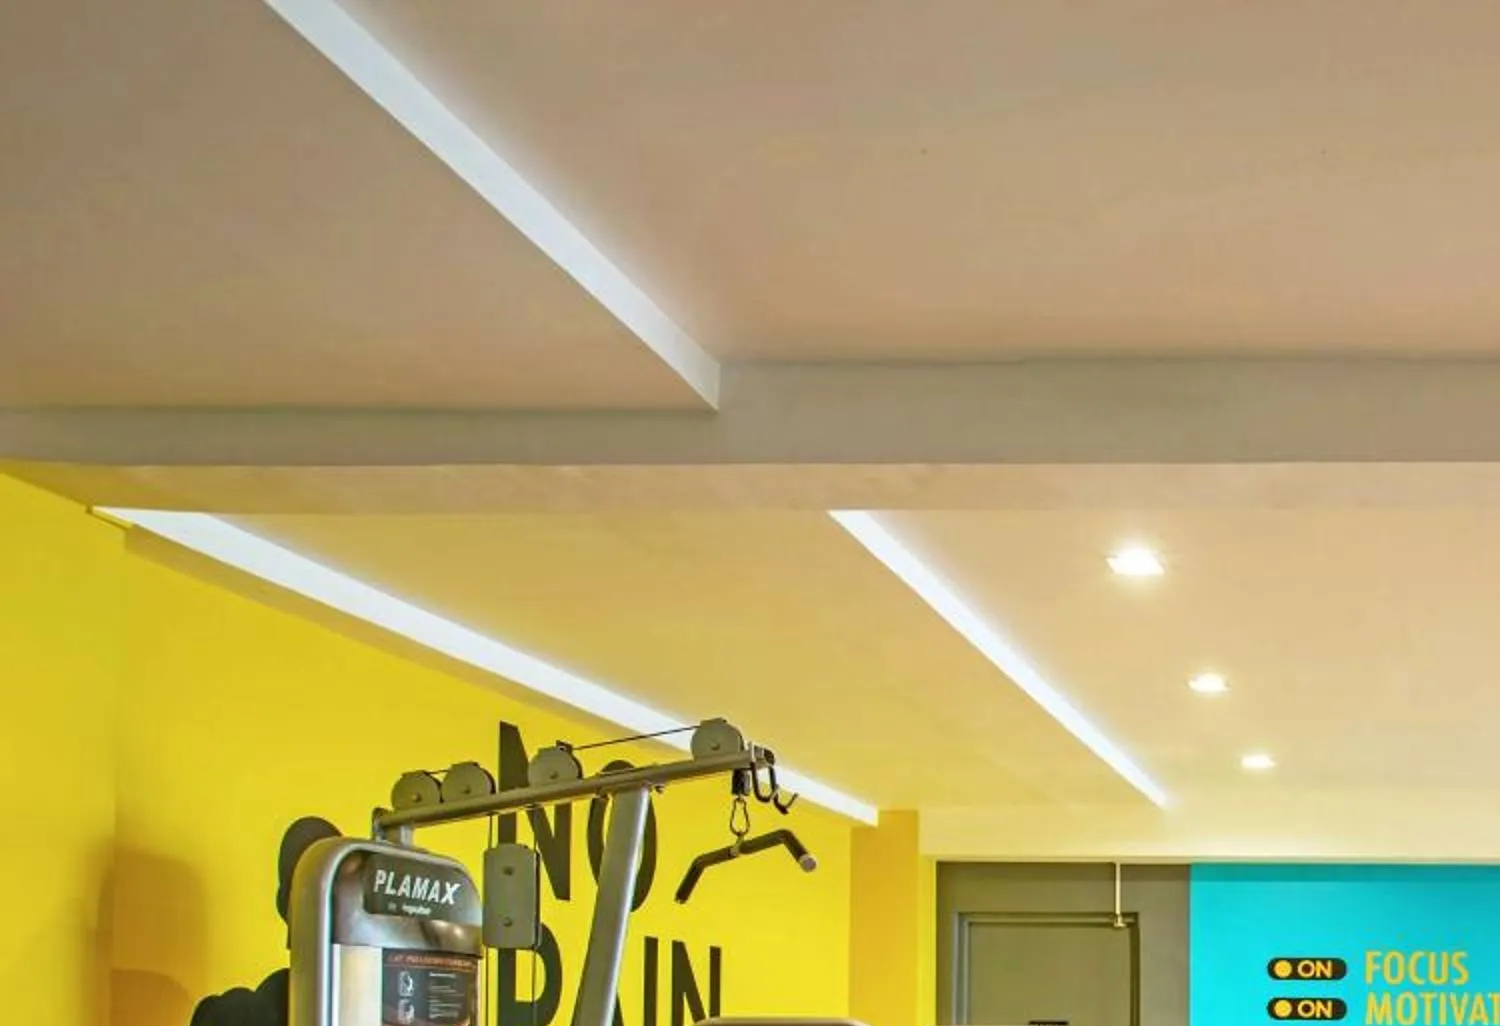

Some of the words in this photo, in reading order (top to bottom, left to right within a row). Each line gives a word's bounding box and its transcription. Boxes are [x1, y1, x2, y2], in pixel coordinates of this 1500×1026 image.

[373, 868, 462, 905] PLAMAX
[1297, 959, 1332, 978] ON
[1364, 951, 1470, 985] FOCUS
[1297, 1000, 1332, 1018] ON
